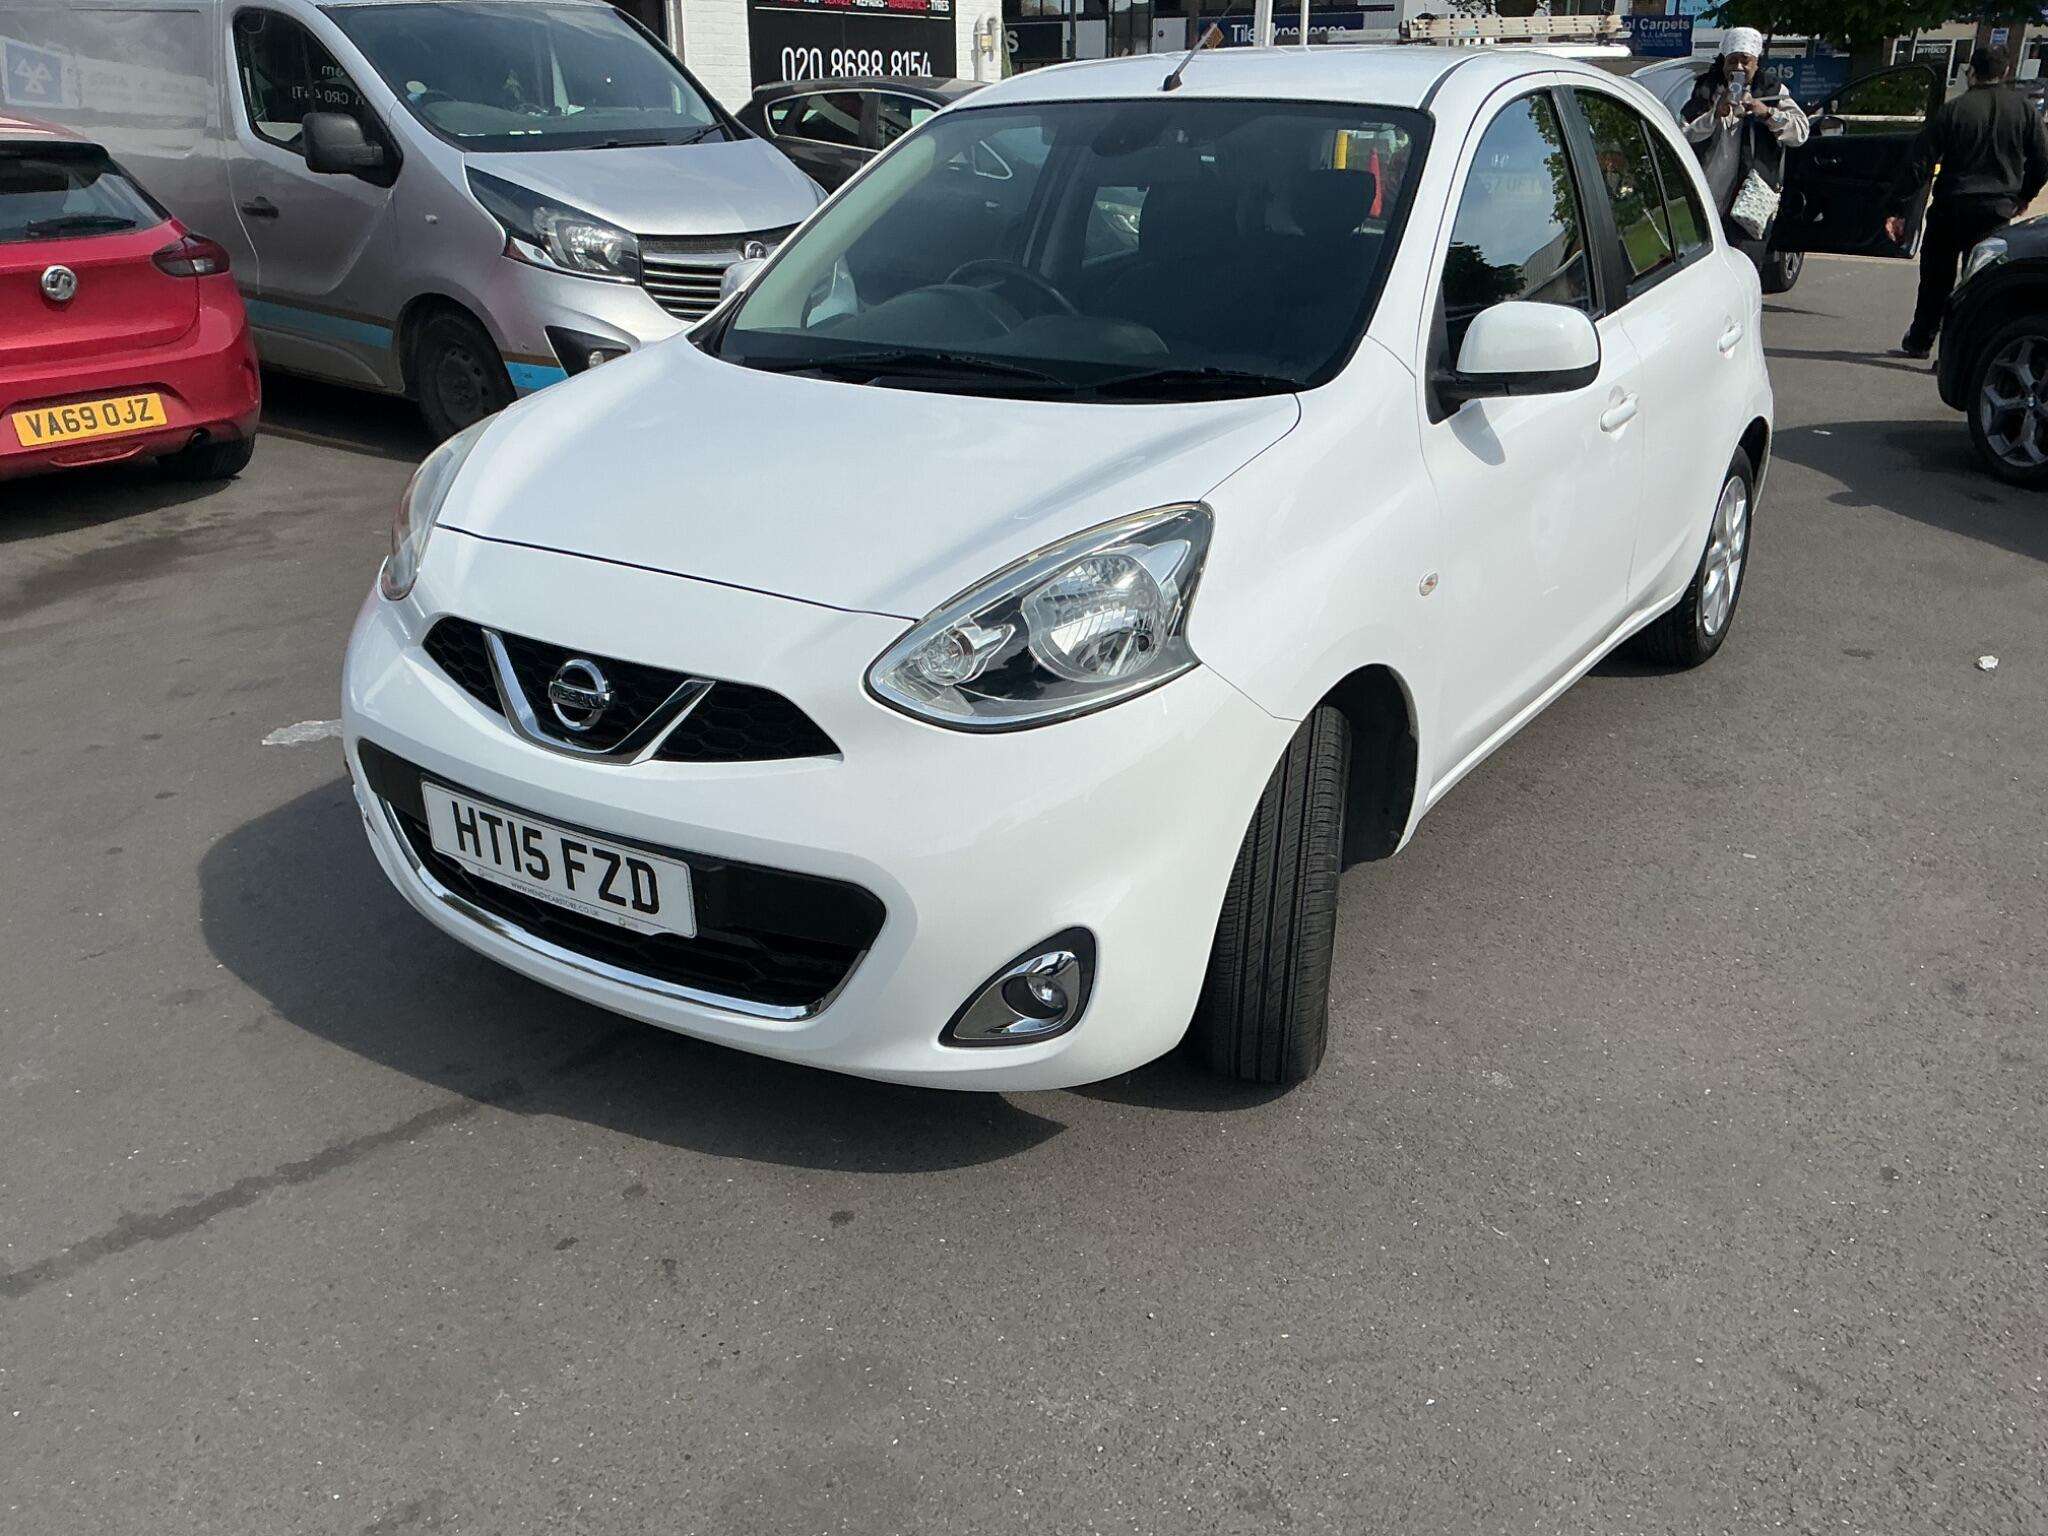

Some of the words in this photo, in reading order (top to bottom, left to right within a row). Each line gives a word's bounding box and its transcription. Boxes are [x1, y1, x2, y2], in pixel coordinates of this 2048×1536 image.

[1639, 18, 1690, 33] Carpets
[781, 47, 823, 80] 020
[830, 48, 883, 77] 8688
[890, 50, 933, 77] 8154
[25, 406, 98, 438] VA69
[102, 397, 154, 426] OJZ
[452, 800, 550, 881] HT15
[560, 837, 659, 915] FZD
